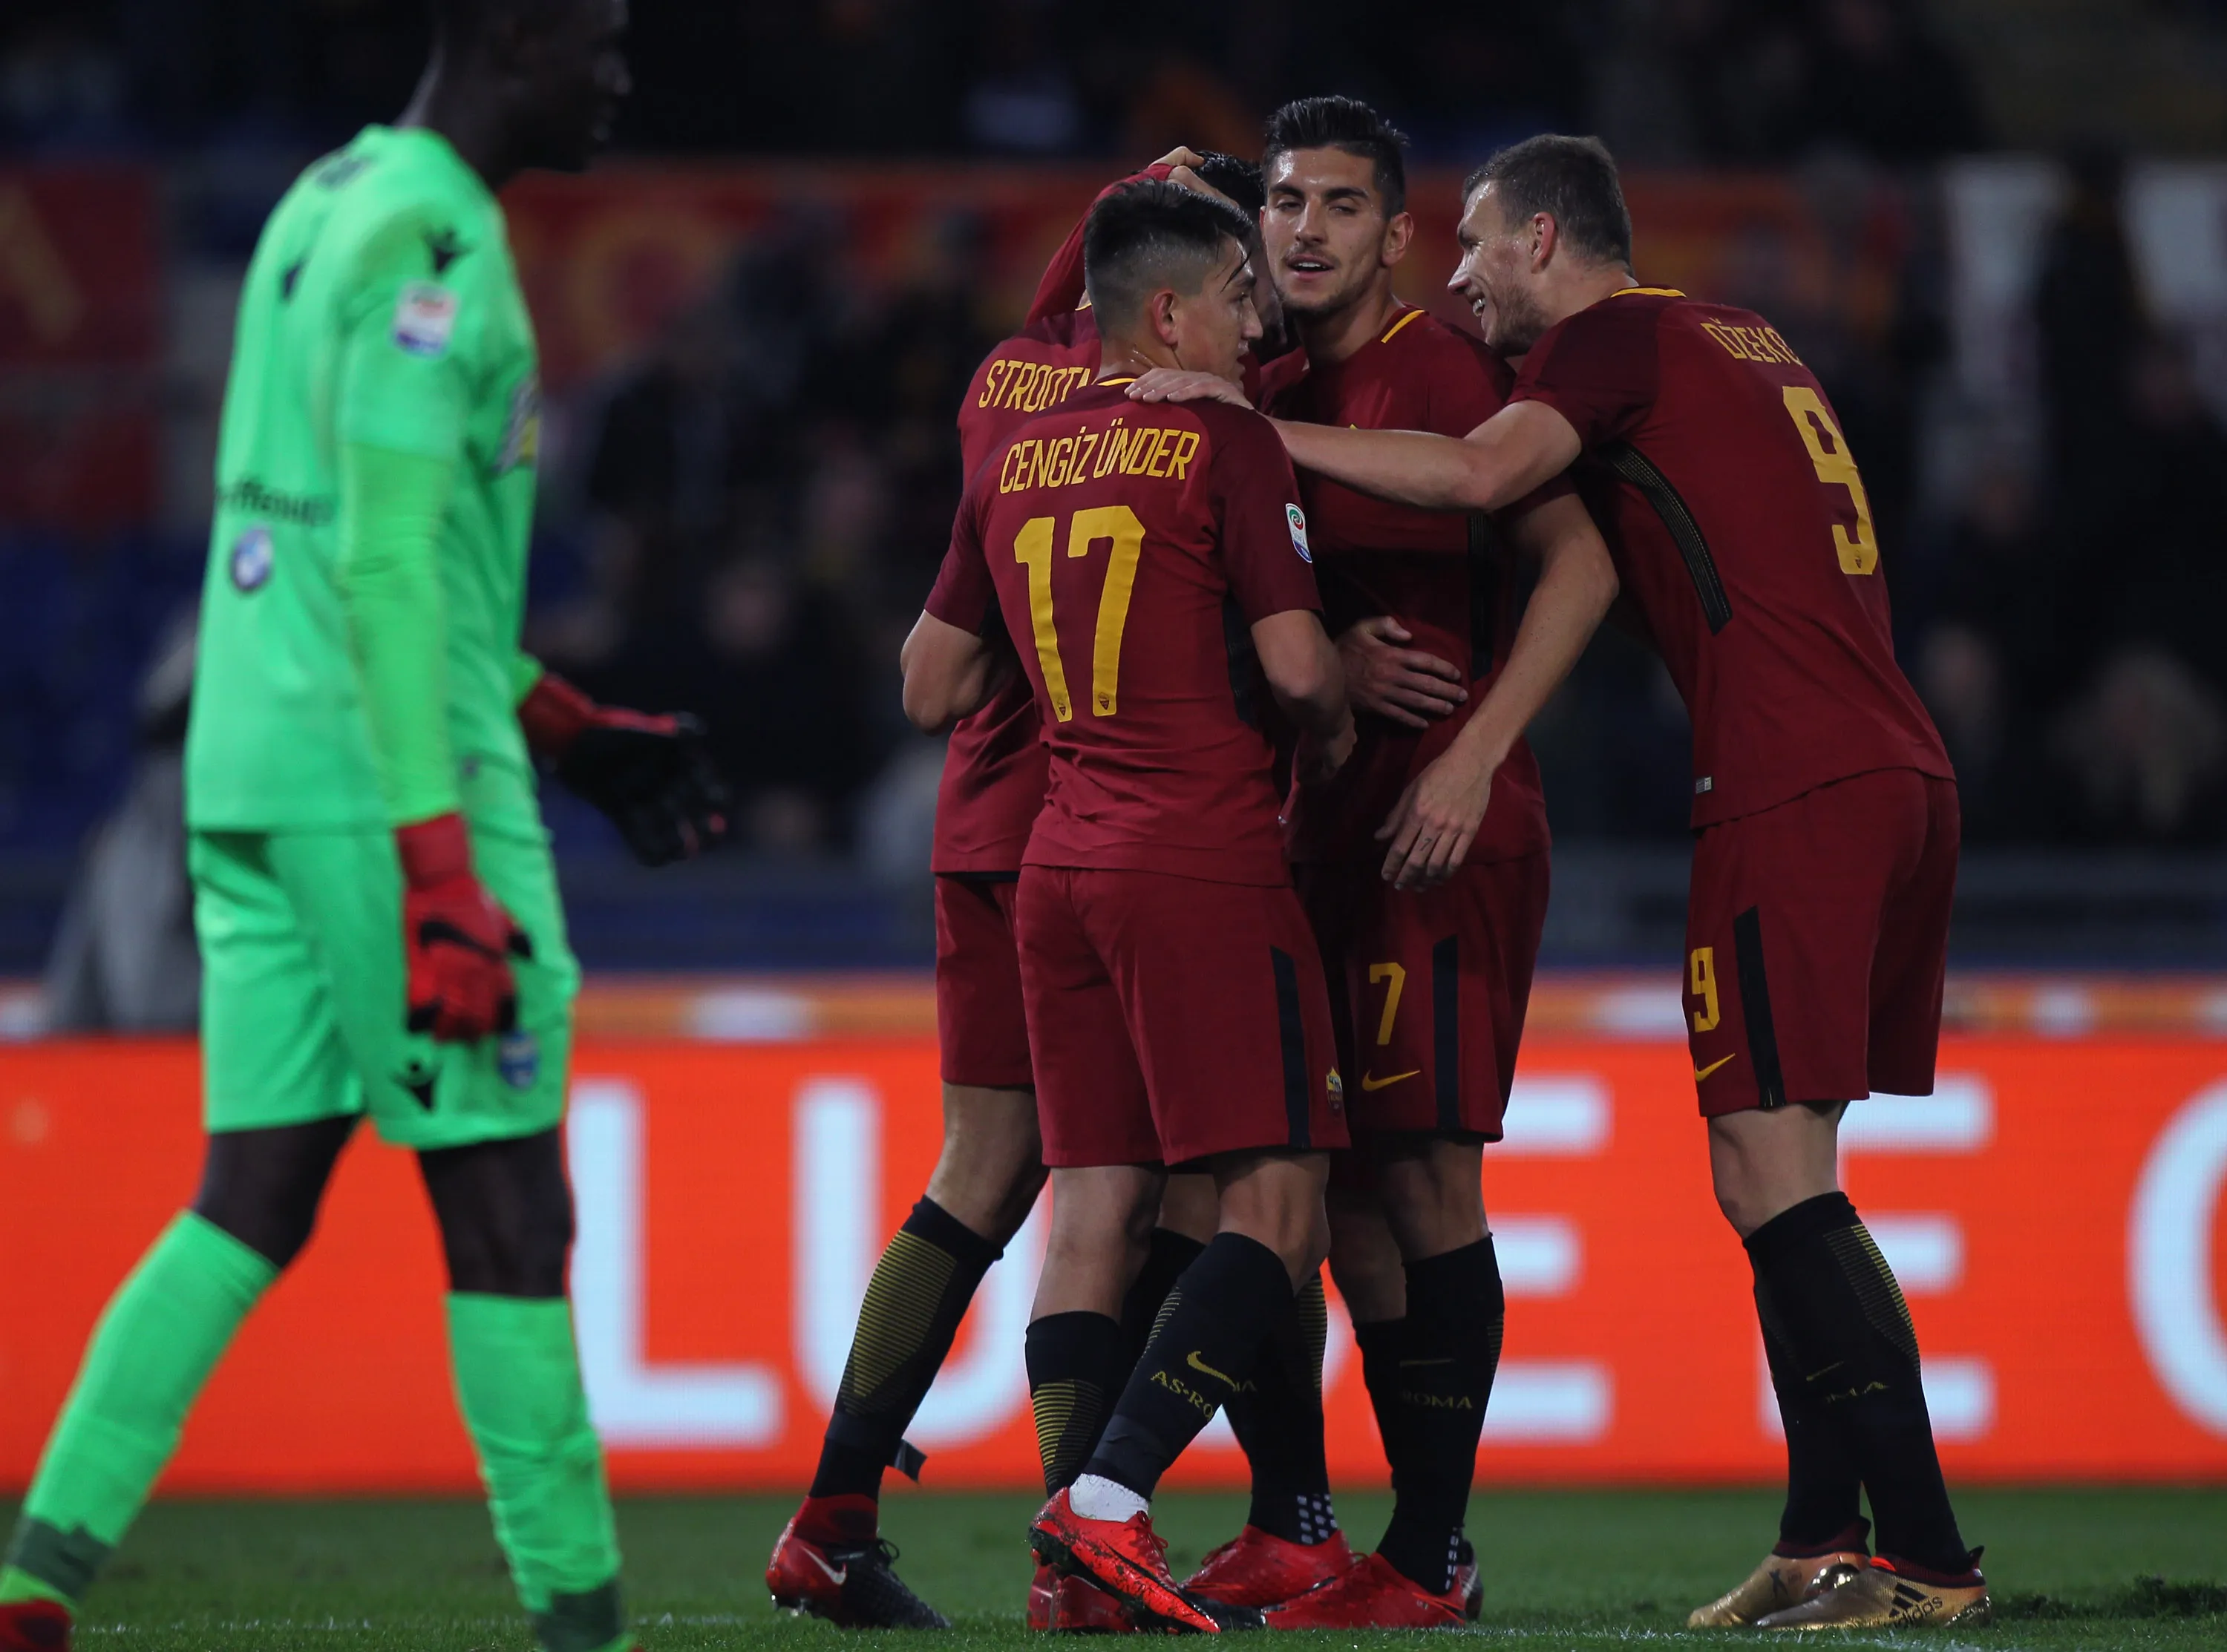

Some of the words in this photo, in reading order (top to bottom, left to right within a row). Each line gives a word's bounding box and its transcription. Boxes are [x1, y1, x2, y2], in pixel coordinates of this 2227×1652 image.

[999, 425, 1099, 494] CENGİZ
[1093, 417, 1200, 481] ÜNDER
[1782, 386, 1878, 575] 9
[1013, 505, 1146, 724] 17
[1369, 962, 1406, 1045] 7
[1691, 946, 1721, 1032] 9
